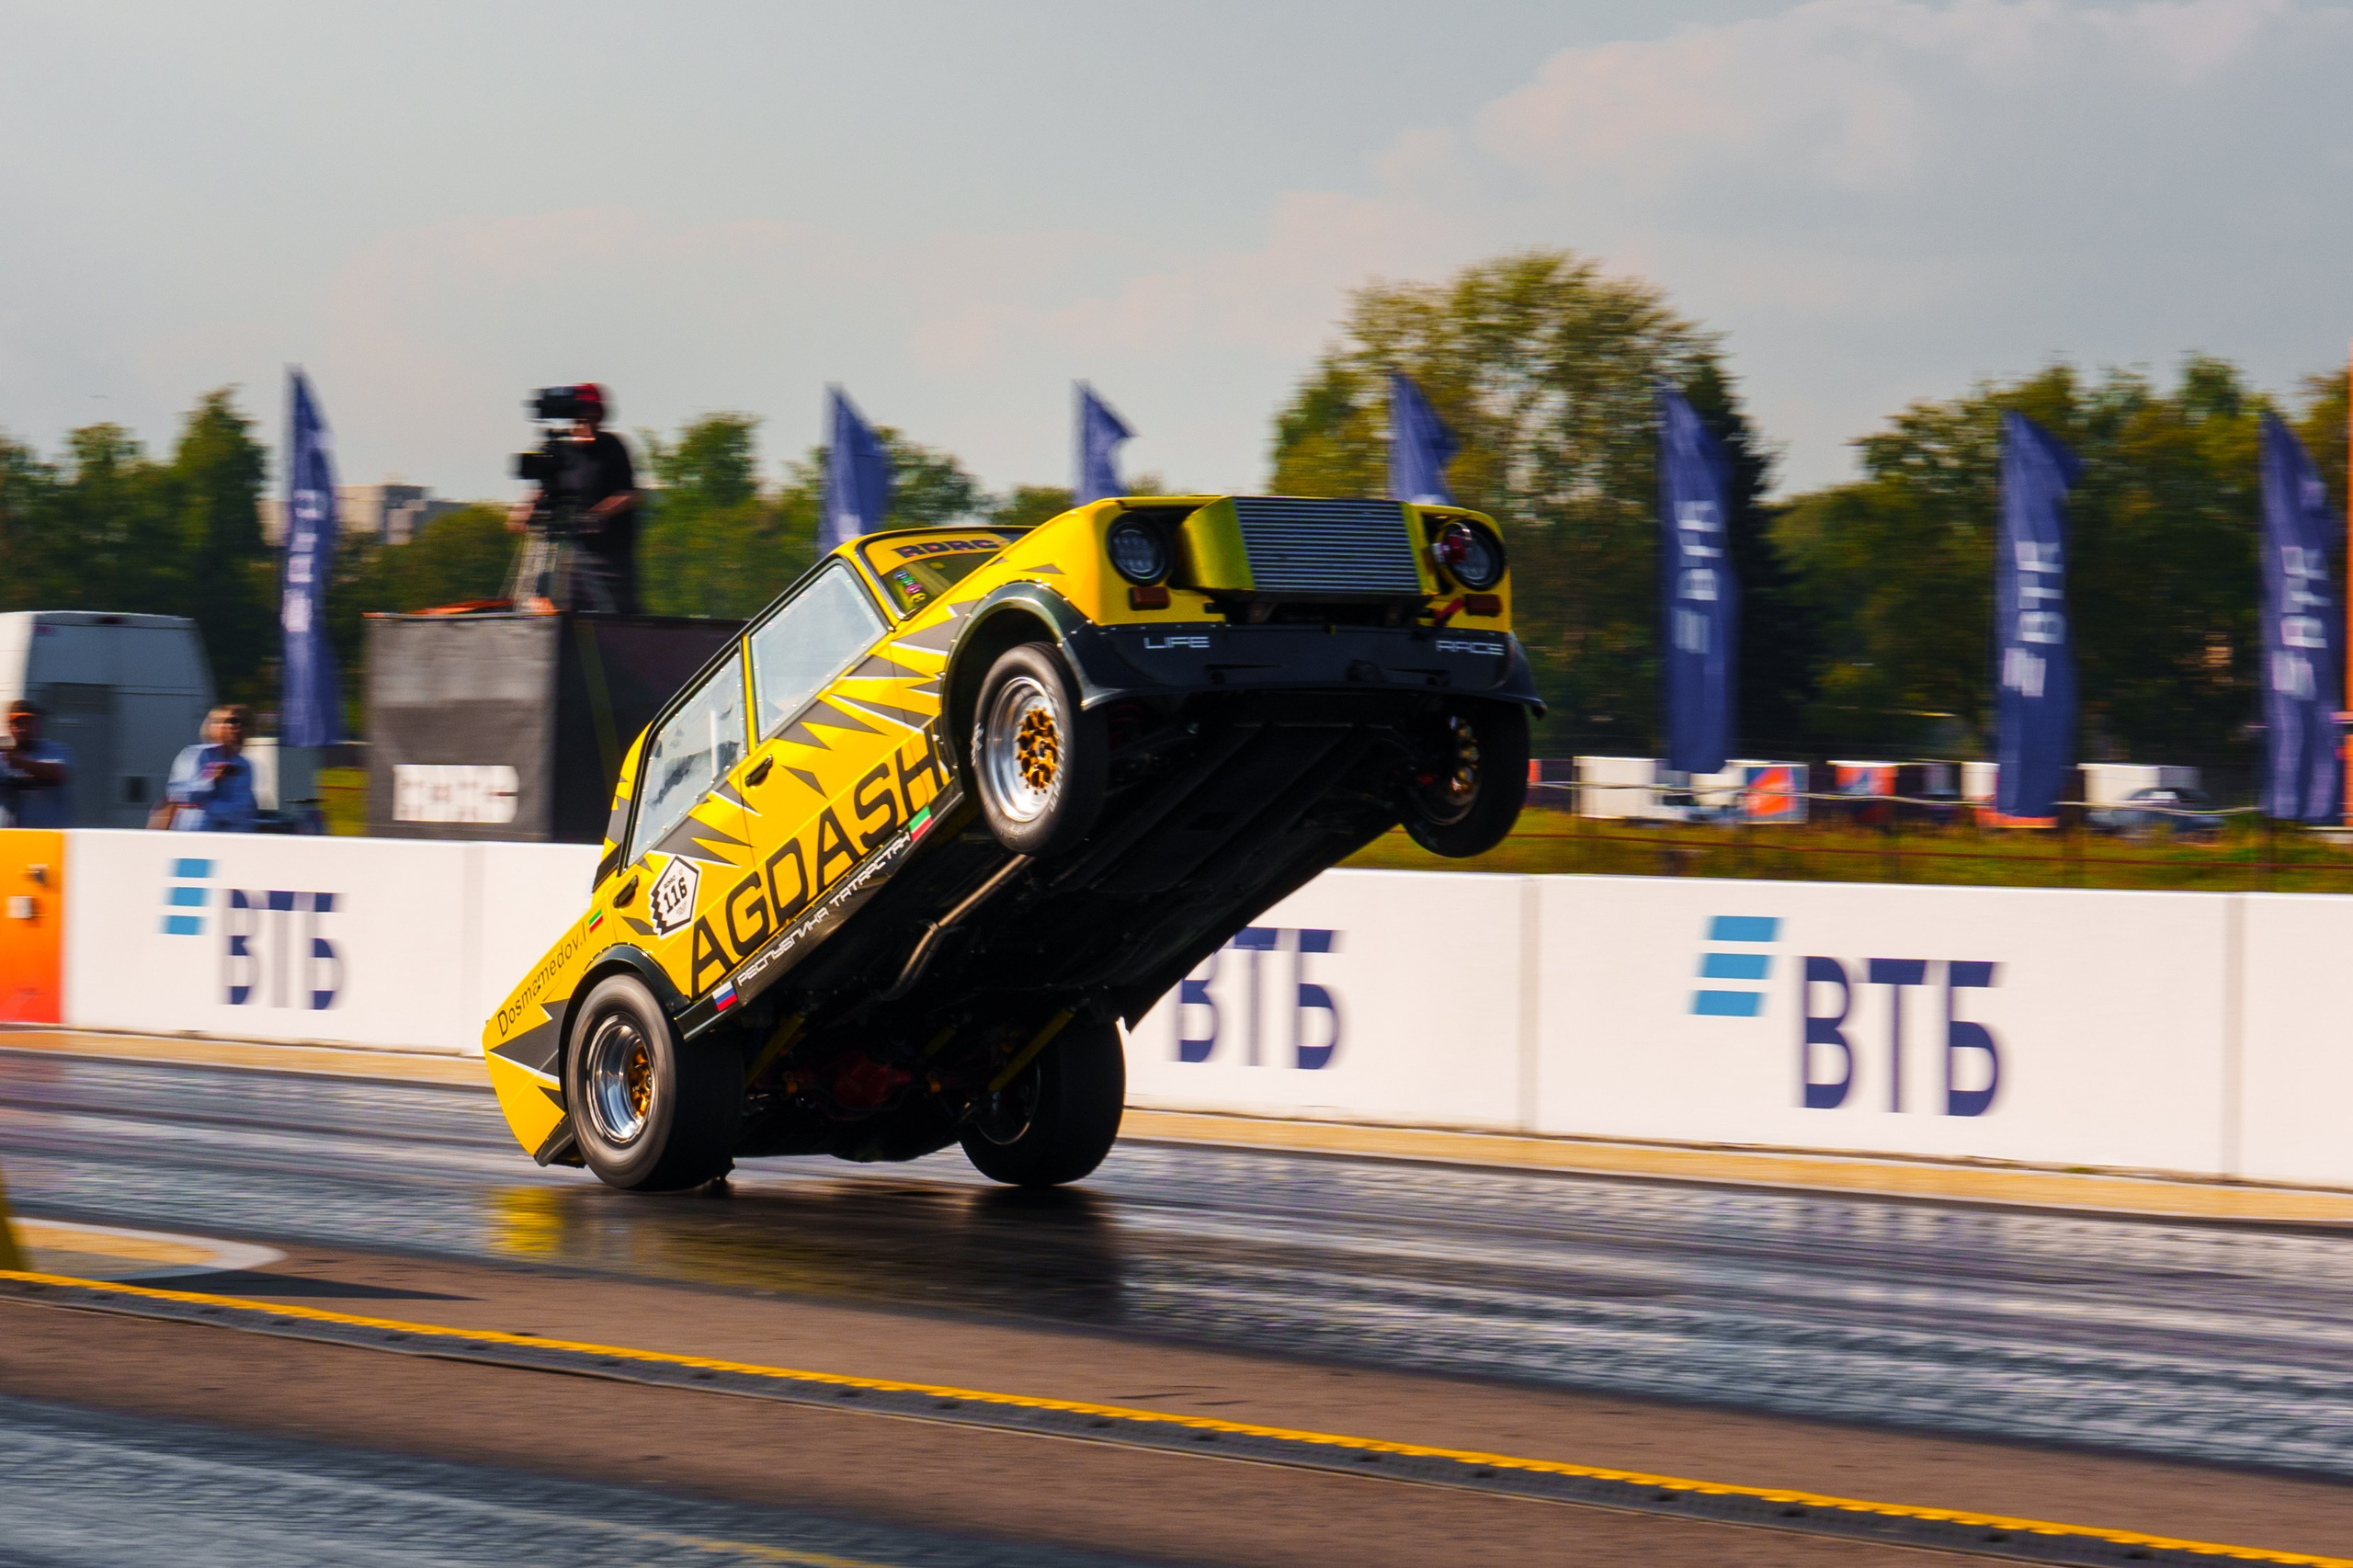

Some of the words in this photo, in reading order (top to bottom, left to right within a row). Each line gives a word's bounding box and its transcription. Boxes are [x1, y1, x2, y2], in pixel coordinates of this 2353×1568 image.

[891, 539, 1001, 559] RDRC
[1143, 636, 1210, 649] LIFE
[1436, 640, 1505, 655] RACE
[663, 876, 688, 915] 116
[691, 728, 945, 998] AGDASH
[736, 906, 830, 987] РЕСПУБЛИКА
[829, 831, 911, 908] ТАТАРСТАН
[220, 888, 346, 1011] ВТБ
[1794, 955, 2006, 1117] ВТБ
